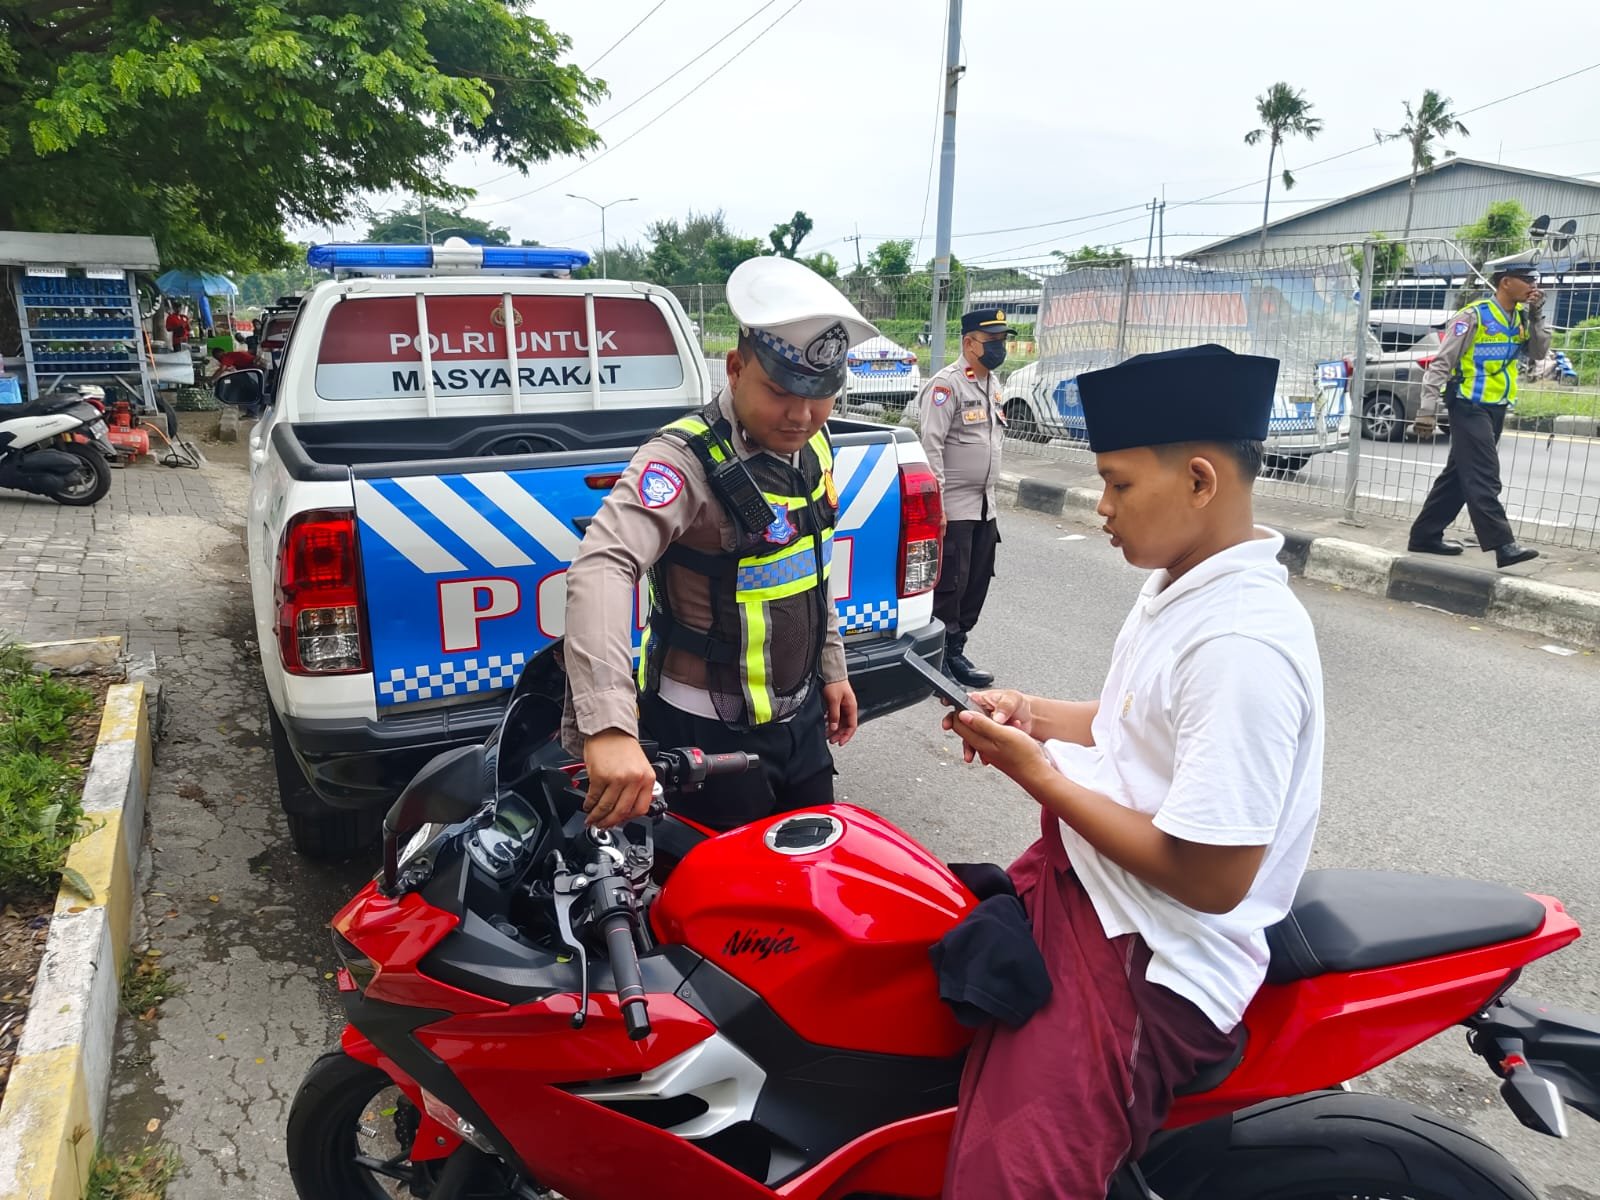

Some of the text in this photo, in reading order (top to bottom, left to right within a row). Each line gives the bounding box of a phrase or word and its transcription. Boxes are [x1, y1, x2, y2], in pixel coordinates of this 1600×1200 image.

[389, 331, 496, 355] POLRI
[392, 364, 622, 392] MASYARAKAT
[722, 927, 800, 963] Ninja
